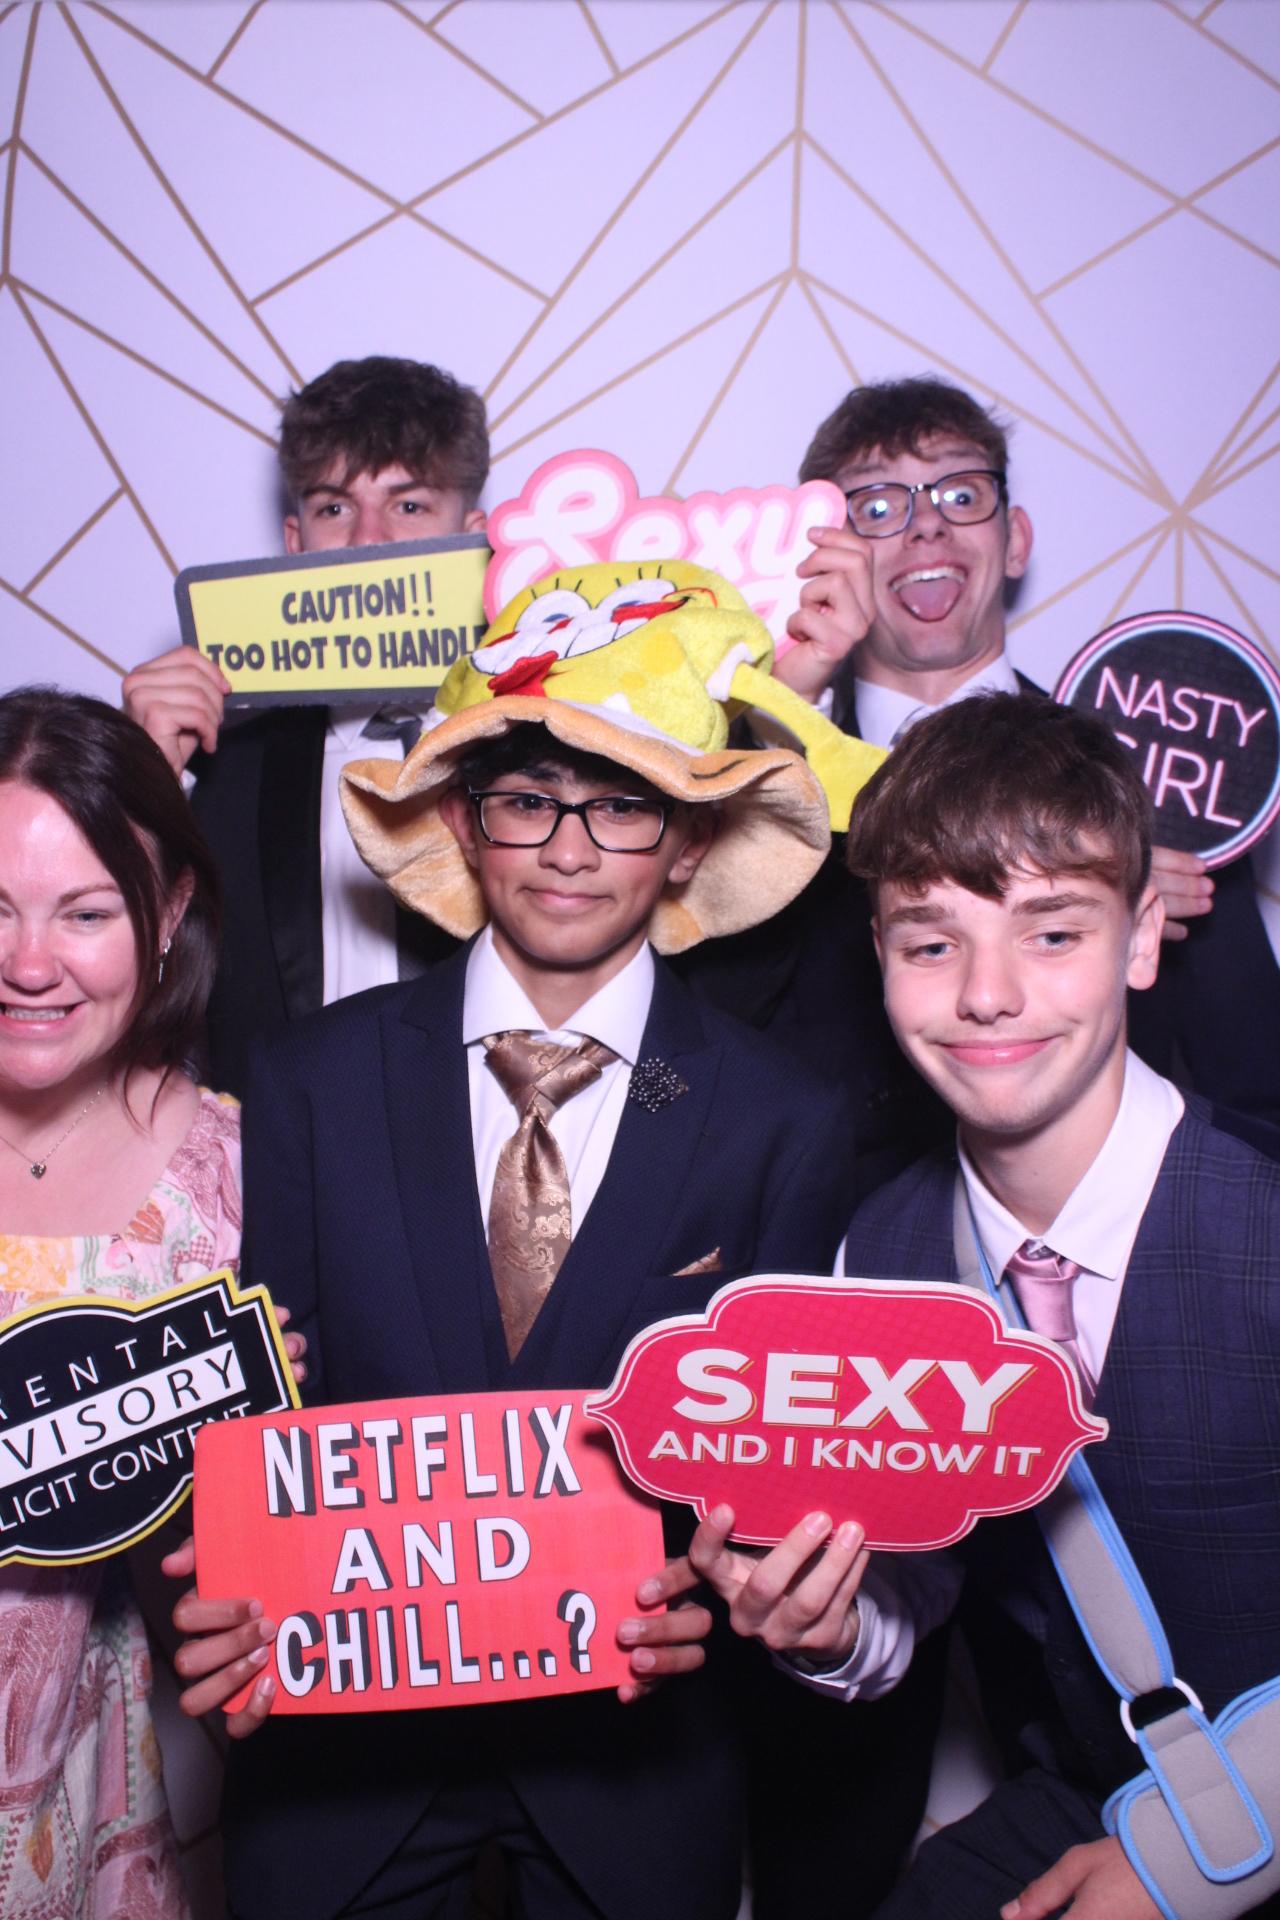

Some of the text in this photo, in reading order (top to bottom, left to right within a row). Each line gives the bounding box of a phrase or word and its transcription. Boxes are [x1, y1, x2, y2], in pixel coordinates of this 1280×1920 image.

[281, 571, 435, 625] CAUTION!!
[206, 643, 265, 671] TOO
[271, 636, 328, 672] HOT
[334, 634, 372, 669] TO
[1095, 666, 1267, 747] NASTY
[1113, 732, 1243, 828] IRL
[0, 1310, 228, 1420] ENTAL
[672, 1347, 1039, 1434] SEXY
[261, 1404, 583, 1518] NETFLIX
[648, 1429, 1043, 1477] AND I KNOW IT
[331, 1516, 532, 1595] AND
